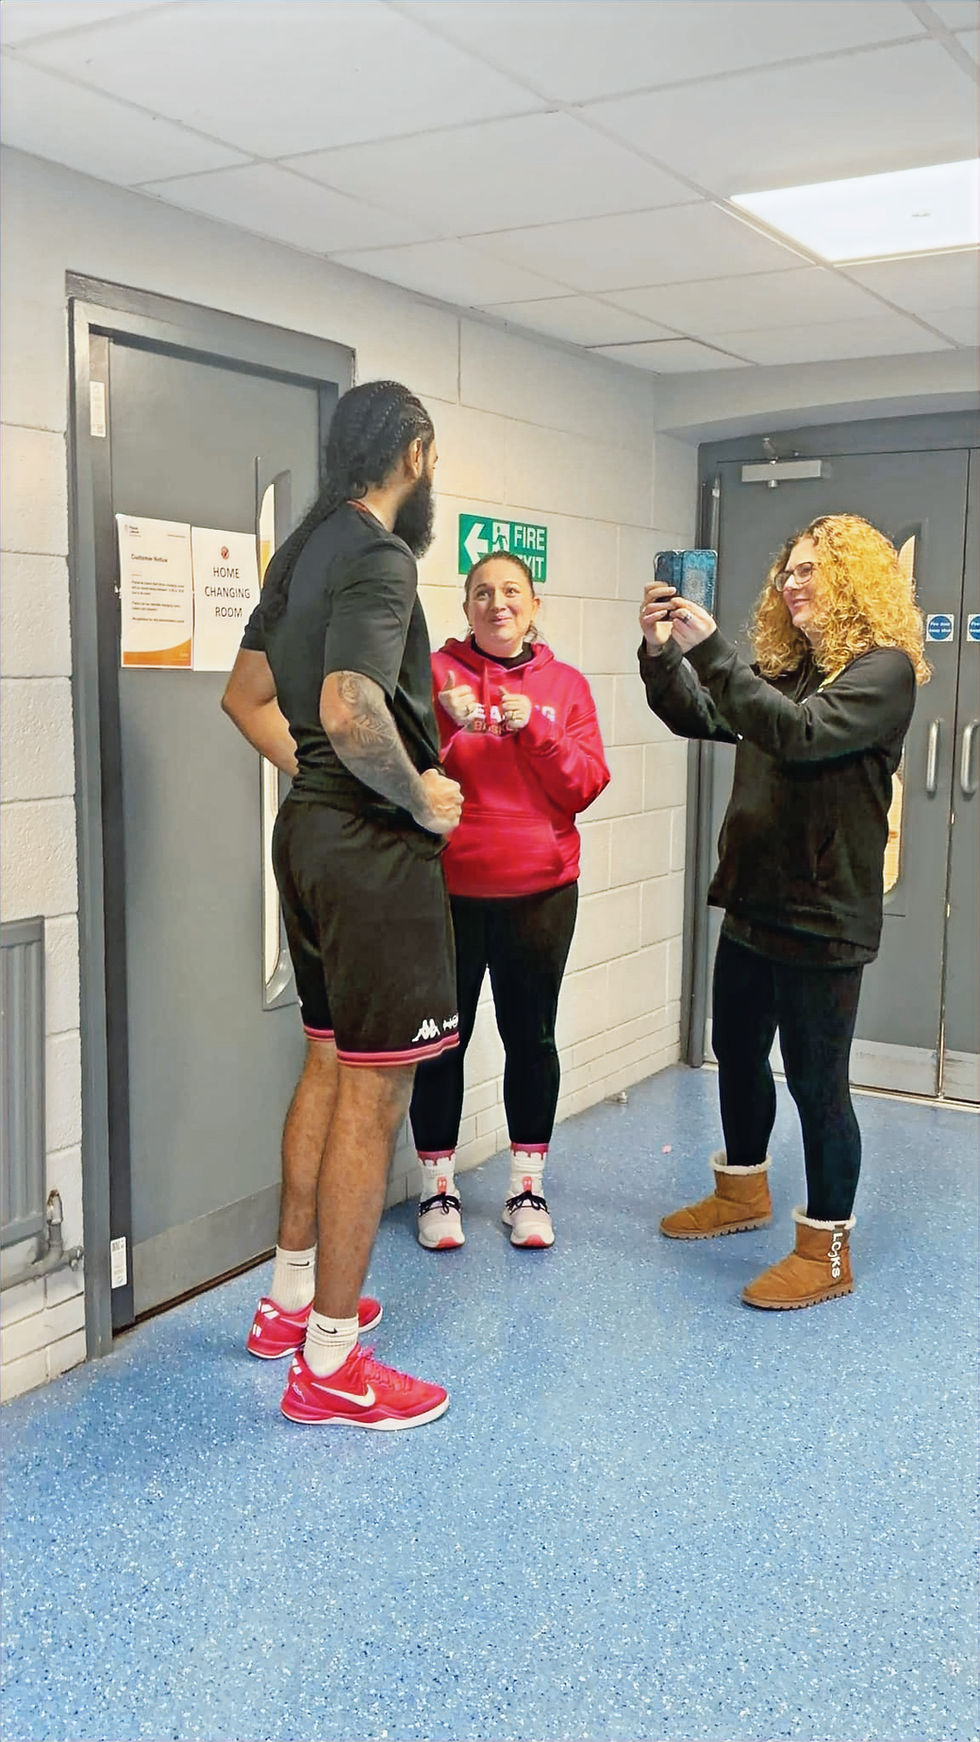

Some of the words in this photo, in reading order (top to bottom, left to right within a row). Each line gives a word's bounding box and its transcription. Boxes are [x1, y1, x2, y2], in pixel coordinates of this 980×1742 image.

[514, 525, 545, 551] FIRE
[213, 567, 240, 579] HOME
[516, 554, 545, 578] XIT
[204, 585, 251, 599] CHANGING
[215, 606, 243, 618] ROOM
